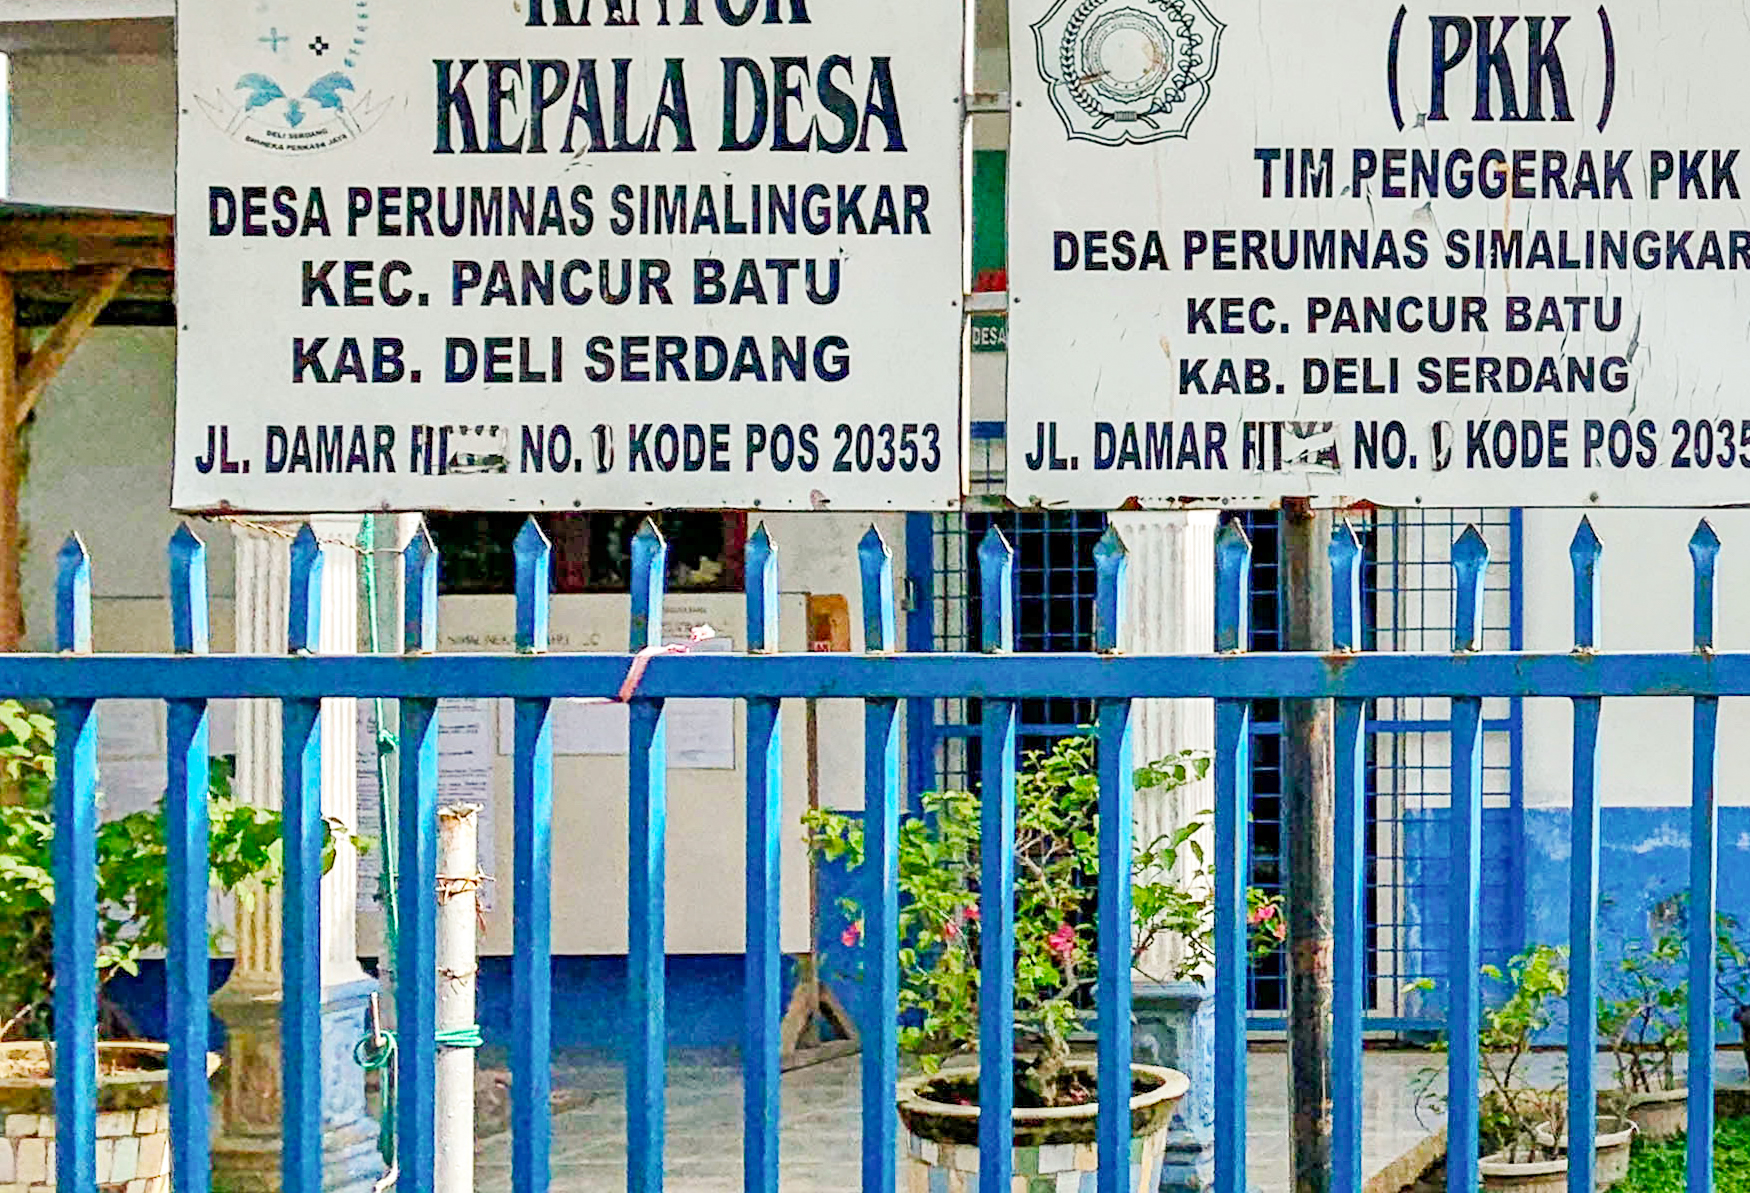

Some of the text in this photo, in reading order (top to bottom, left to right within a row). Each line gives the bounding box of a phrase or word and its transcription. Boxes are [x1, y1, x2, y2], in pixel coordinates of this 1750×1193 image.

[433, 55, 907, 154] KEPALA DESA
[1254, 148, 1740, 199] TIM PENGGERAK PKK
[209, 184, 930, 237] DESA PERUMNAS SIMALINGKAR
[1054, 230, 1169, 271] DESA
[1184, 229, 1427, 270] PERUMNAS
[302, 259, 839, 306] KEC. PANCUR BATU
[1188, 296, 1621, 334] KEC. PANCUR BATU
[293, 336, 849, 383] KAB. DELI SERDANG
[1180, 357, 1628, 394] KAB. DELI SERDANG
[196, 426, 249, 474] JL.
[266, 425, 395, 473] DAMAR
[521, 425, 581, 473] NO.
[629, 424, 730, 472] KODE
[747, 424, 818, 472] POS
[833, 424, 940, 472] 20353
[1026, 422, 1078, 470] JL.
[1094, 422, 1228, 469] DAMAR
[1355, 421, 1416, 469] NO.
[1467, 420, 1567, 468] KODE
[1585, 420, 1656, 468] POS
